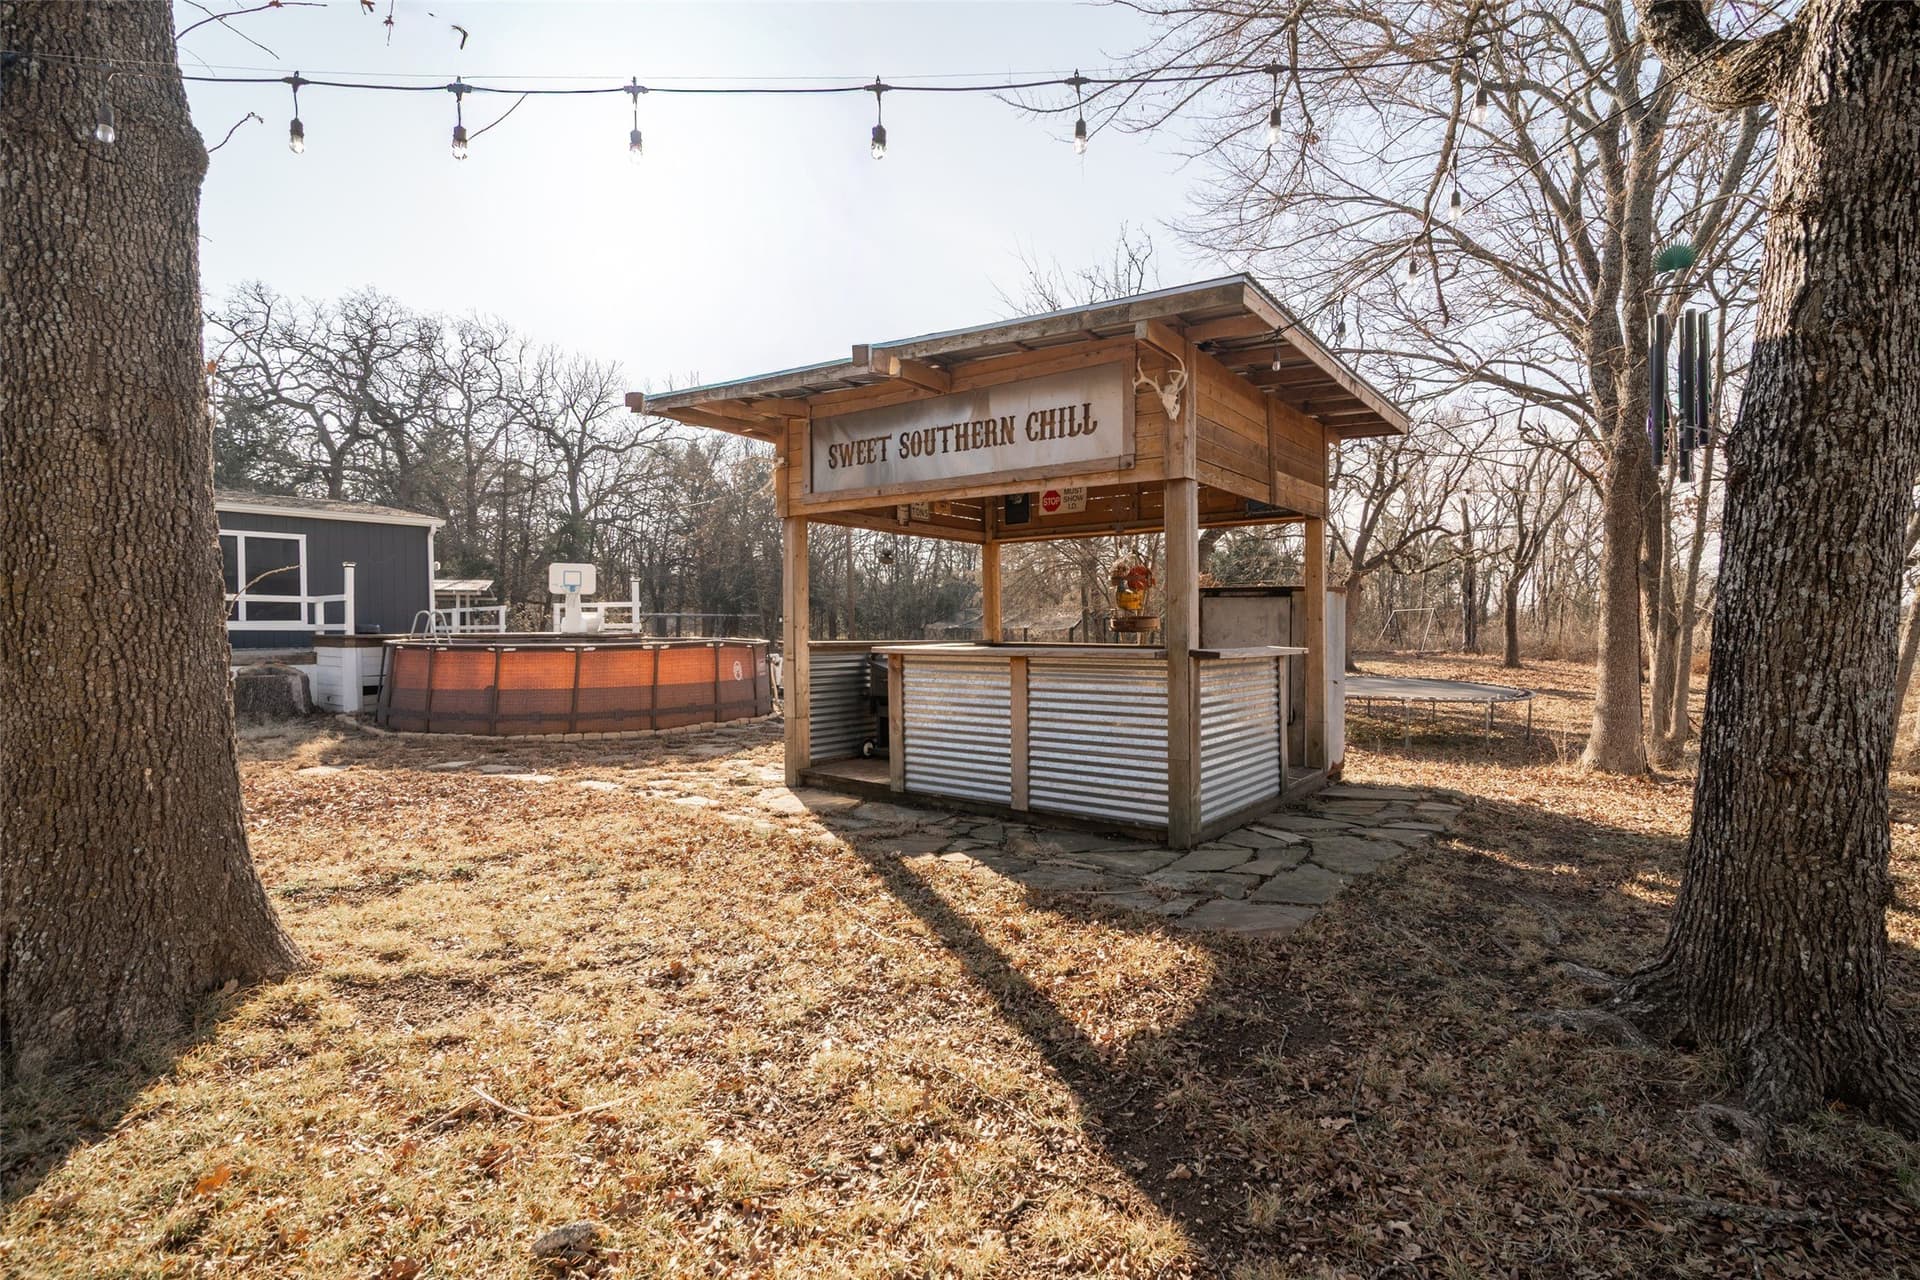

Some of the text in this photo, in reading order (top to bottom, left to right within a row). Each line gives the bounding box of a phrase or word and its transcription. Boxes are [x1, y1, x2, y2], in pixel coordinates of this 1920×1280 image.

[828, 402, 1098, 469] SWEET SOUTHERN CHILL
[1043, 496, 1061, 506] STOP
[1063, 495, 1083, 503] SHOW
